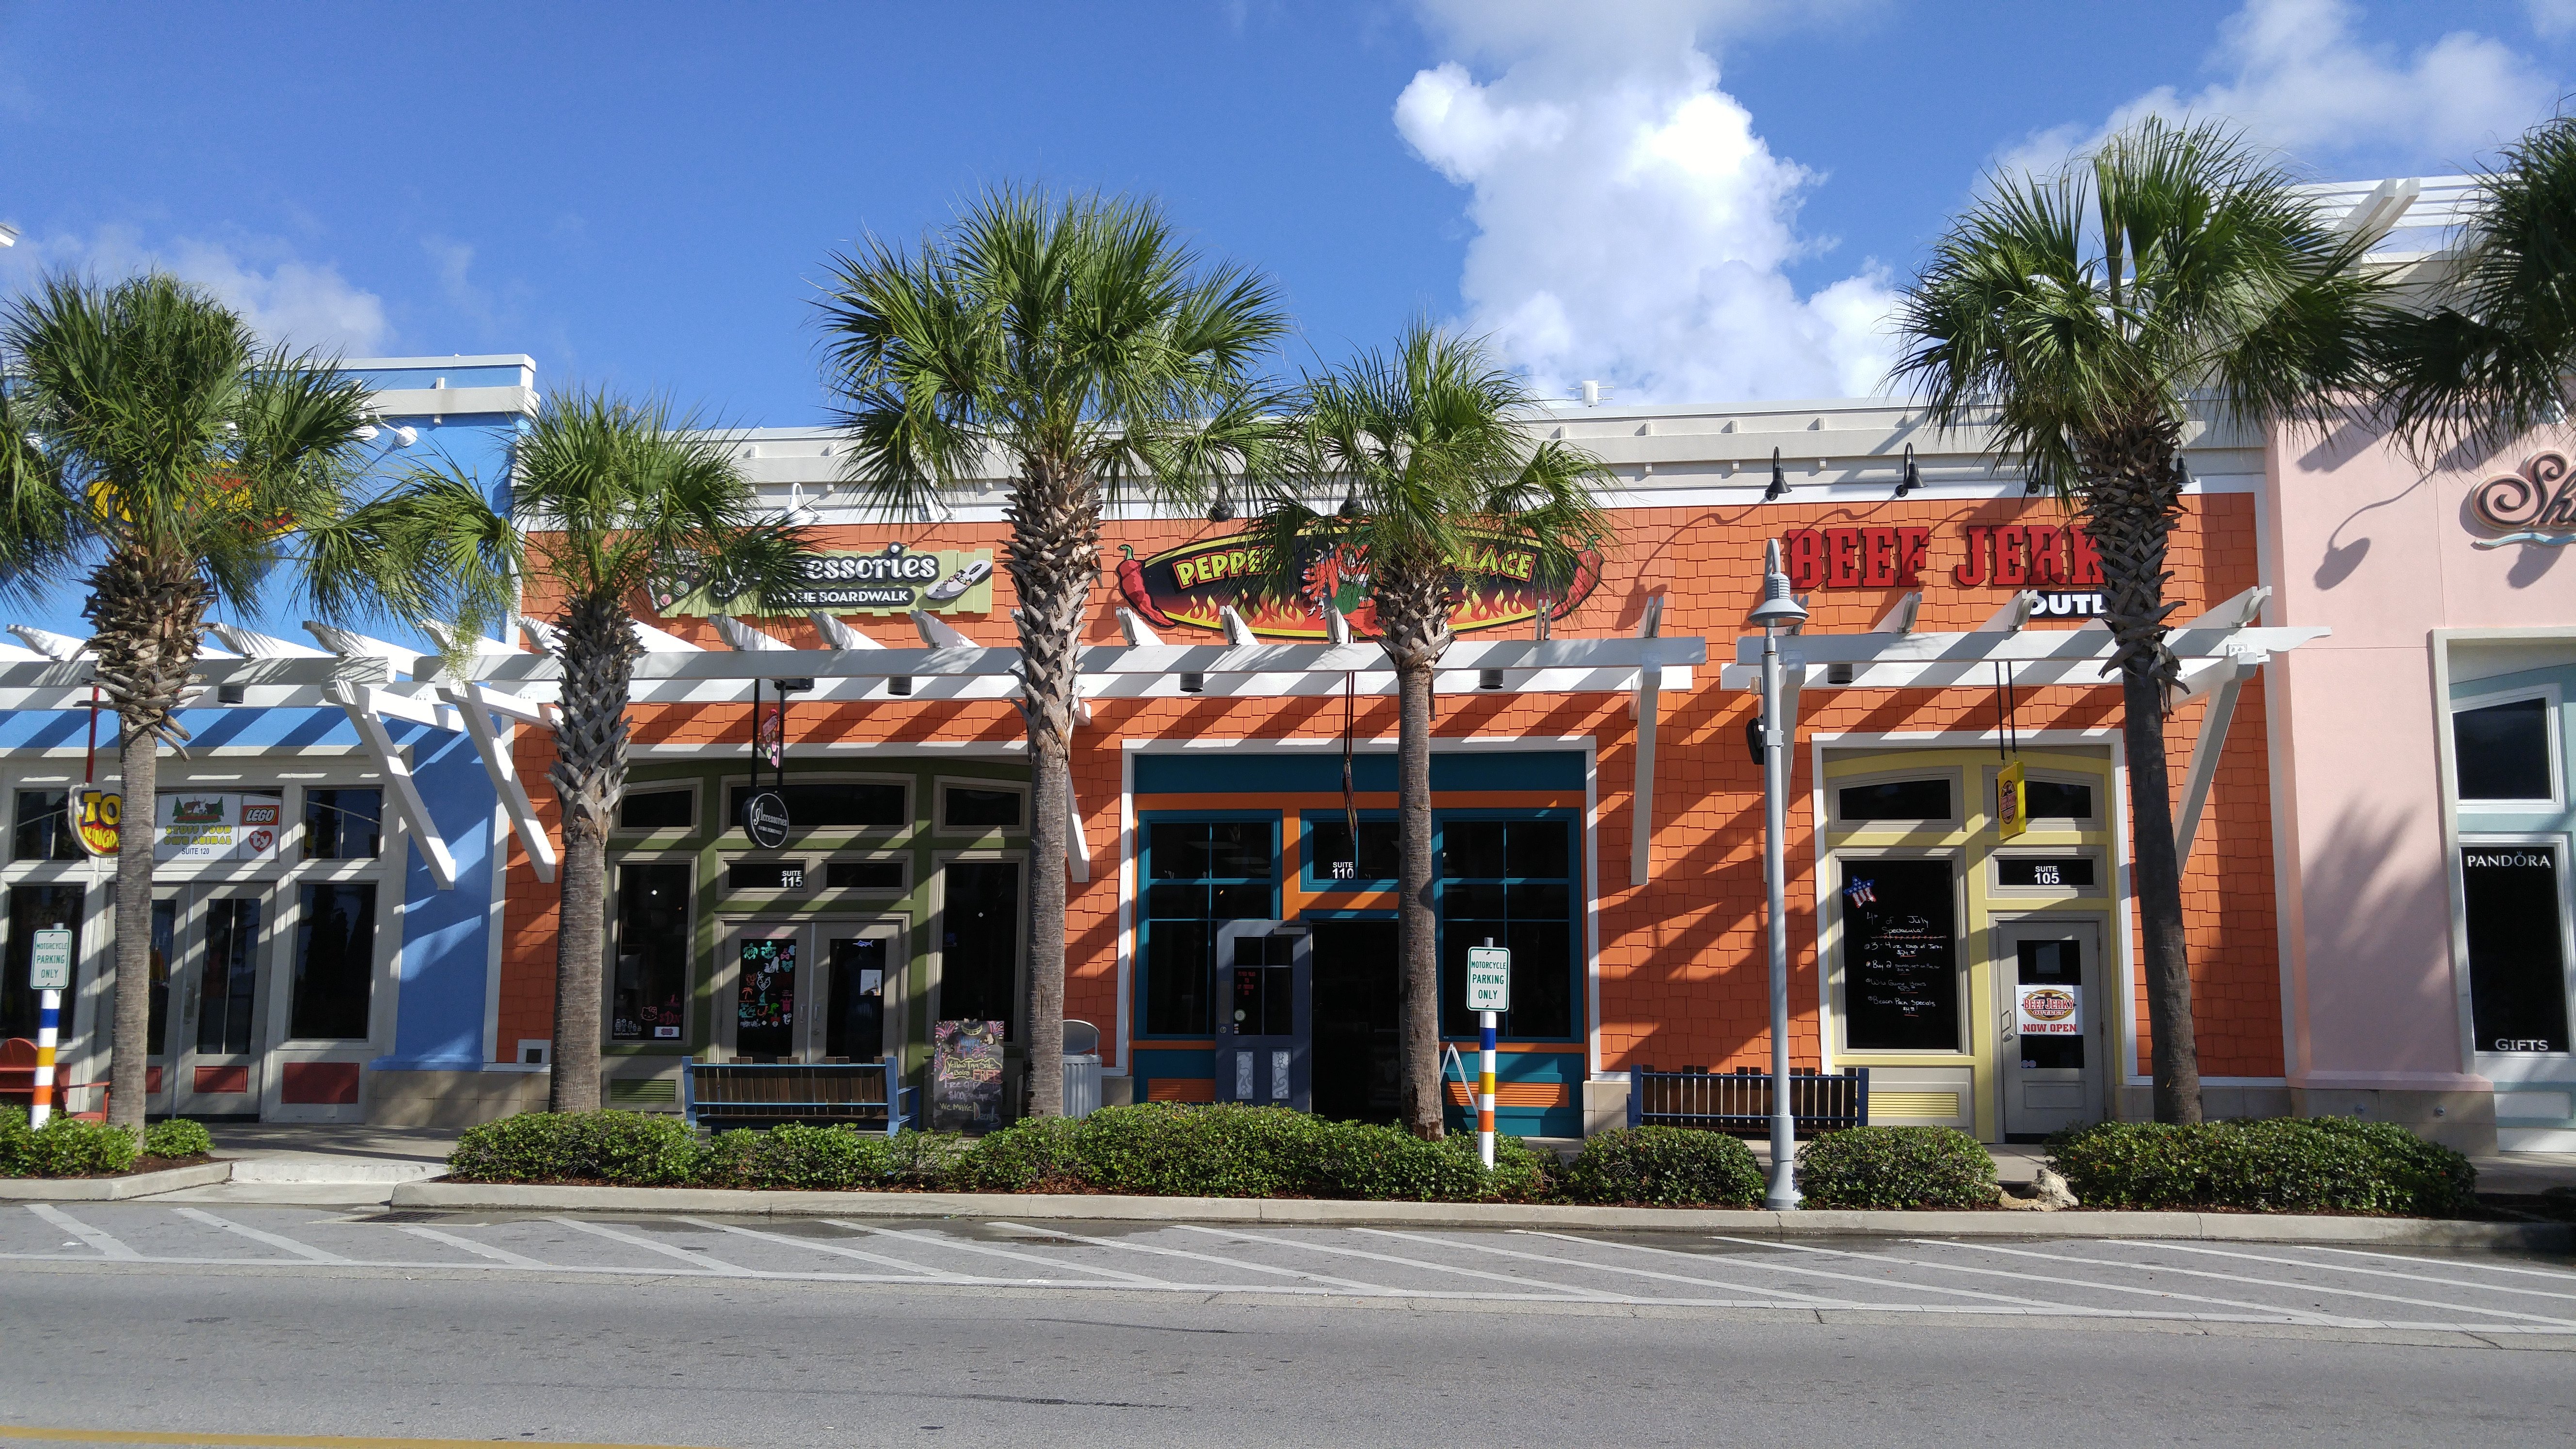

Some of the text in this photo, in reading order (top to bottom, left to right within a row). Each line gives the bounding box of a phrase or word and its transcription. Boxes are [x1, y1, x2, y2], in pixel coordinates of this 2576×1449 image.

[1787, 525, 2105, 589] BEEF JERK
[822, 590, 908, 603] BOARDWALK
[2029, 594, 2107, 615] OUTL
[81, 790, 121, 827] TO
[754, 802, 787, 826] Accessories
[244, 808, 275, 822] LEGO
[165, 825, 232, 834] STUFF YOUR
[84, 827, 119, 848] KINGD
[163, 836, 232, 845] OWN ANIMAL
[250, 832, 270, 849] ty
[2467, 853, 2551, 867] PANDORA
[1333, 868, 1354, 879] 110
[2034, 872, 2060, 884] 105
[781, 876, 803, 887] 115
[1907, 916, 1929, 928] July
[1882, 926, 1925, 937] Spectacular
[37, 955, 65, 964] PARKING
[1471, 961, 1506, 969] MOTORCYCLE
[1872, 960, 1884, 971] Buy
[41, 969, 59, 978] ONLY
[1472, 974, 1504, 984] PARKING
[1478, 989, 1497, 999] ONLY
[1911, 999, 1936, 1010] Specials
[2024, 998, 2074, 1009] BEEF JERKY
[2023, 1024, 2077, 1032] NOW OPEN
[2495, 1038, 2548, 1051] GIFTS
[947, 1060, 966, 1073] Yellow
[973, 1069, 1002, 1082] FREE
